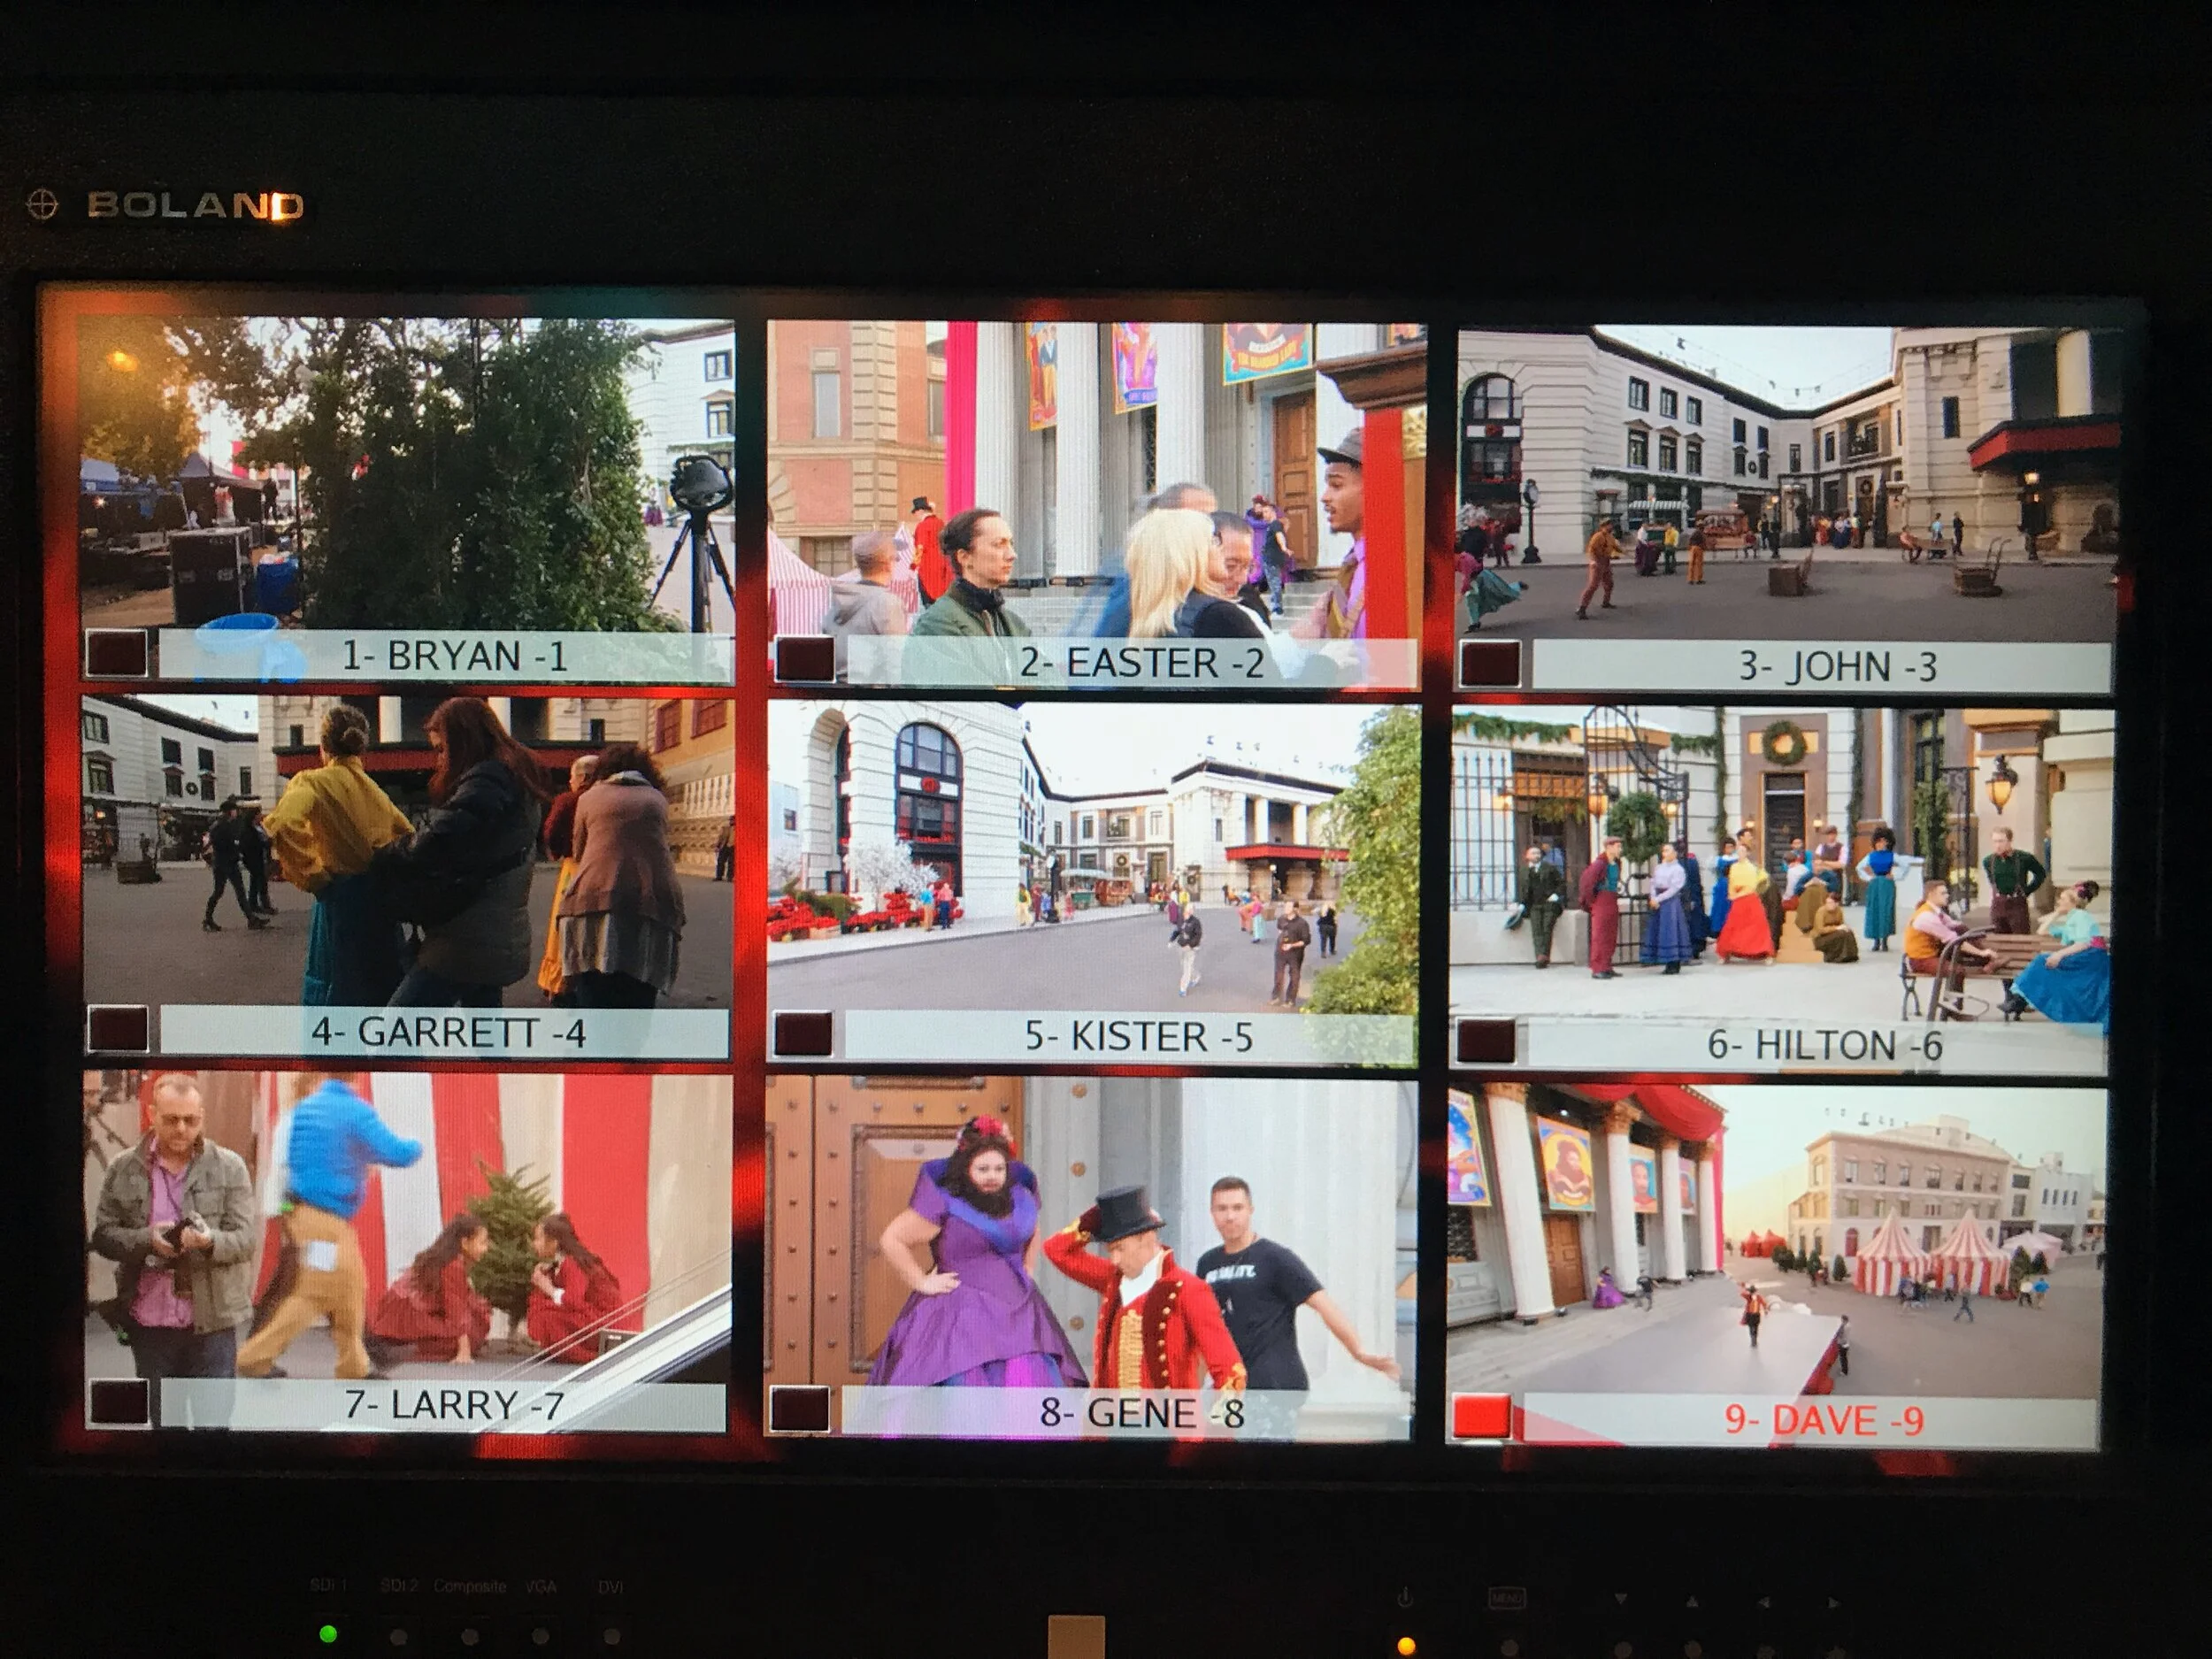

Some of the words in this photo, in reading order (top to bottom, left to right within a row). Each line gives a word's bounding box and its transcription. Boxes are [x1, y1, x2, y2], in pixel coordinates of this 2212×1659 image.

[88, 190, 305, 220] BOLAND
[343, 640, 376, 671] 1-
[389, 640, 520, 672] BRYAN
[534, 641, 568, 672] -1
[1020, 646, 1054, 678] 2-
[1068, 647, 1219, 679] EASTER
[1232, 648, 1264, 679] -2
[1740, 649, 1773, 680] 3-
[1785, 651, 1891, 686] JOHN
[1904, 651, 1938, 682] -3
[311, 1016, 346, 1047] 4-
[358, 1016, 541, 1048] GARRETT
[551, 1018, 588, 1048] -4
[1026, 1020, 1059, 1050] 5-
[1072, 1020, 1207, 1052] KISTER
[1221, 1022, 1253, 1052] -5
[1709, 1029, 1743, 1059] 6-
[1757, 1030, 1896, 1061] HILTON
[1909, 1031, 1944, 1061] -6
[346, 1390, 379, 1418] 7-
[392, 1389, 518, 1420] LARRY
[530, 1392, 565, 1420] -7
[1041, 1397, 1074, 1427] 8-
[1087, 1397, 1196, 1429] GENE
[1210, 1399, 1245, 1429] -8
[1724, 1403, 1760, 1434] 9-
[1774, 1404, 1879, 1437] DAVE
[1890, 1406, 1925, 1437] -9
[380, 1579, 407, 1594] SDI
[410, 1579, 419, 1593] 2
[434, 1579, 508, 1595] Composite
[526, 1580, 558, 1594] VGA
[598, 1580, 624, 1594] DVI
[1492, 1593, 1523, 1605] MENU
